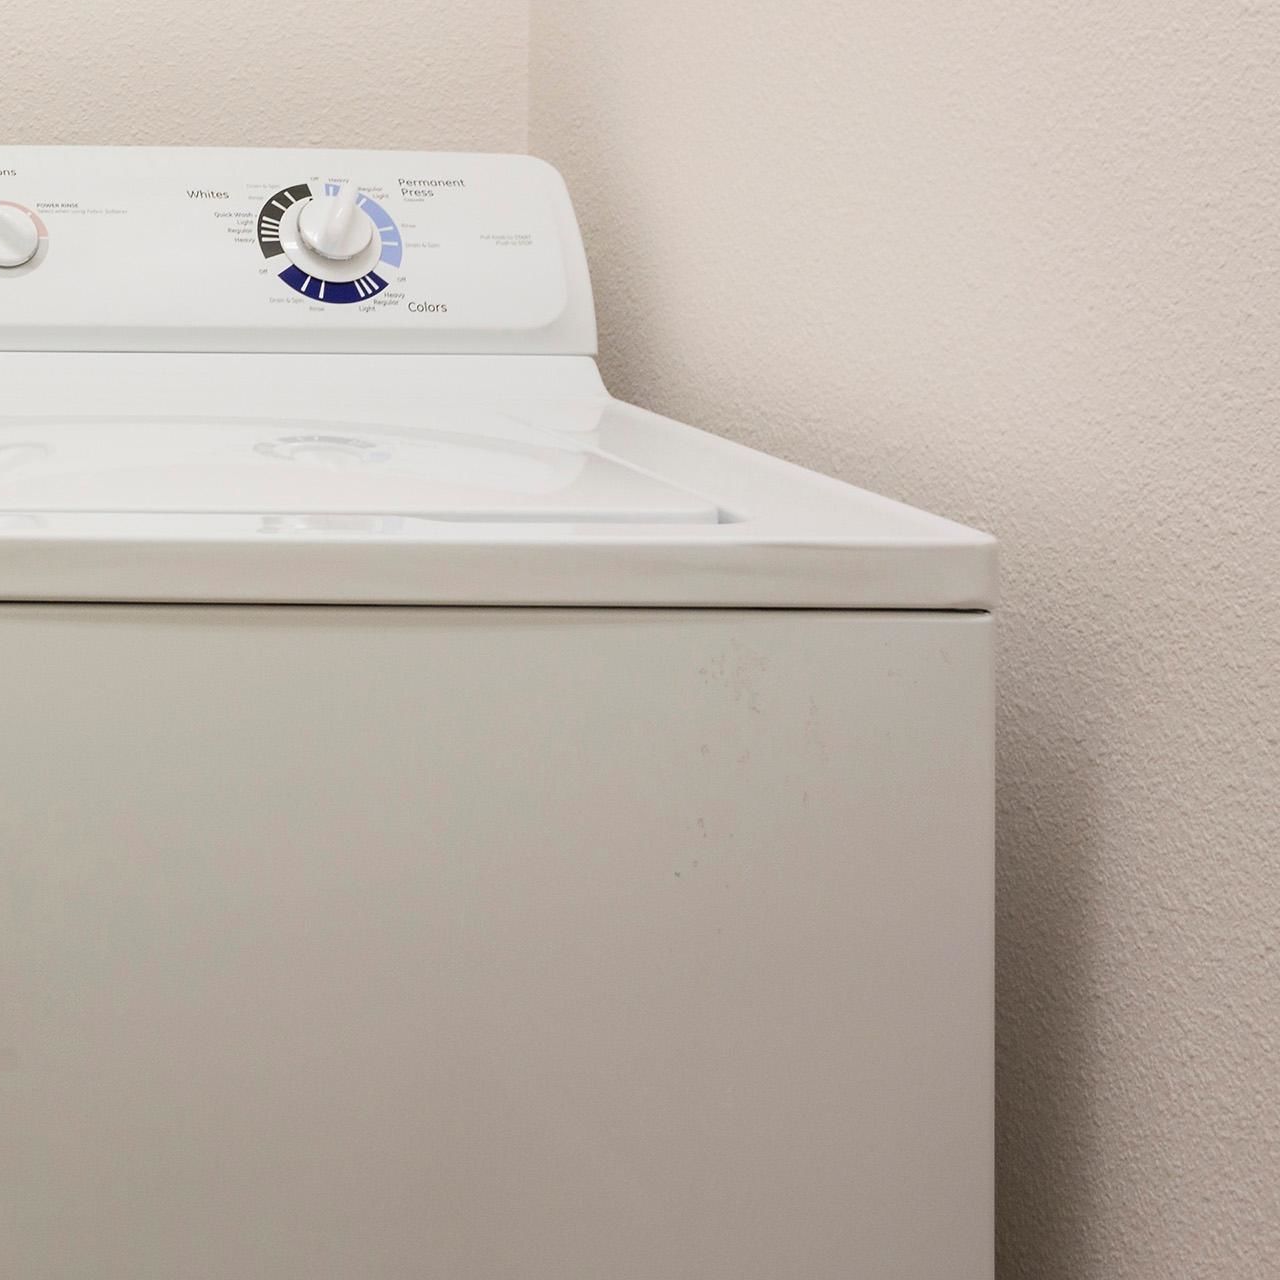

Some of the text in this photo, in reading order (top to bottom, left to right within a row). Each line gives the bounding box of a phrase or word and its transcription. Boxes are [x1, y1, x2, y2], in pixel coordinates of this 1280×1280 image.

[398, 178, 466, 188] Permanent
[186, 189, 230, 199] Whites
[400, 187, 435, 197] Press
[407, 301, 448, 313] Colors
